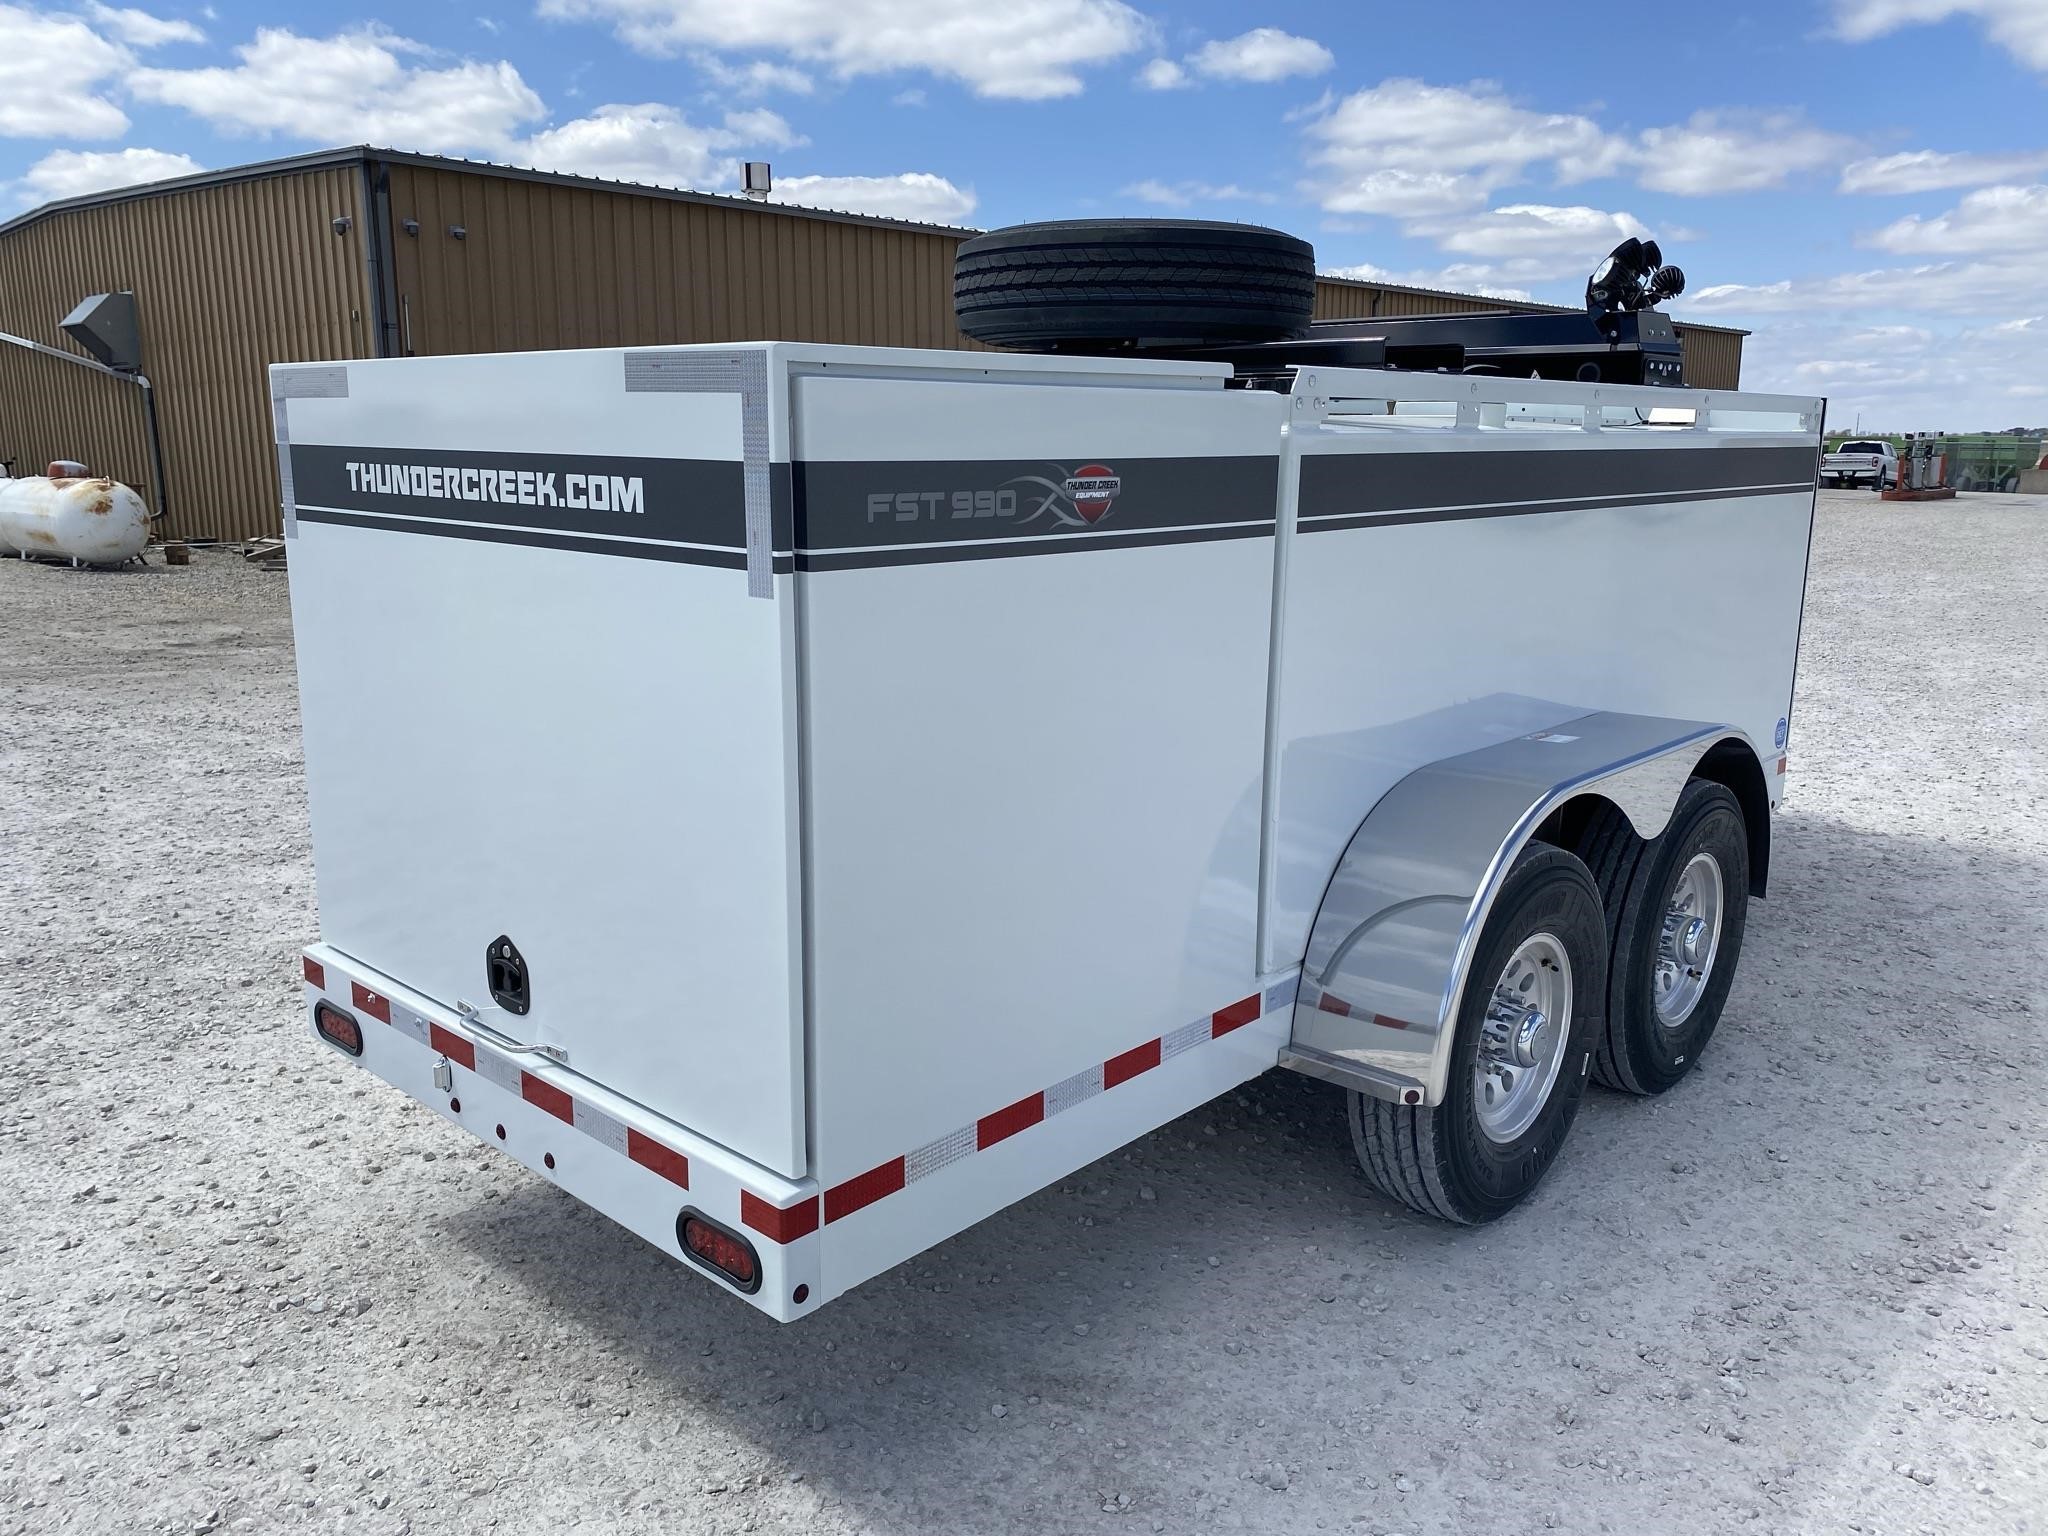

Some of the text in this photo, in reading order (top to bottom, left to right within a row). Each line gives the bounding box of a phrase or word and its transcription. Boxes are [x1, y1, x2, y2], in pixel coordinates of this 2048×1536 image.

[345, 461, 645, 514] THUNDERCREEK.COM
[1066, 480, 1119, 491] THUNDER CREEK
[1075, 491, 1110, 499] EQUIPMENT
[867, 489, 1017, 523] FST 990
